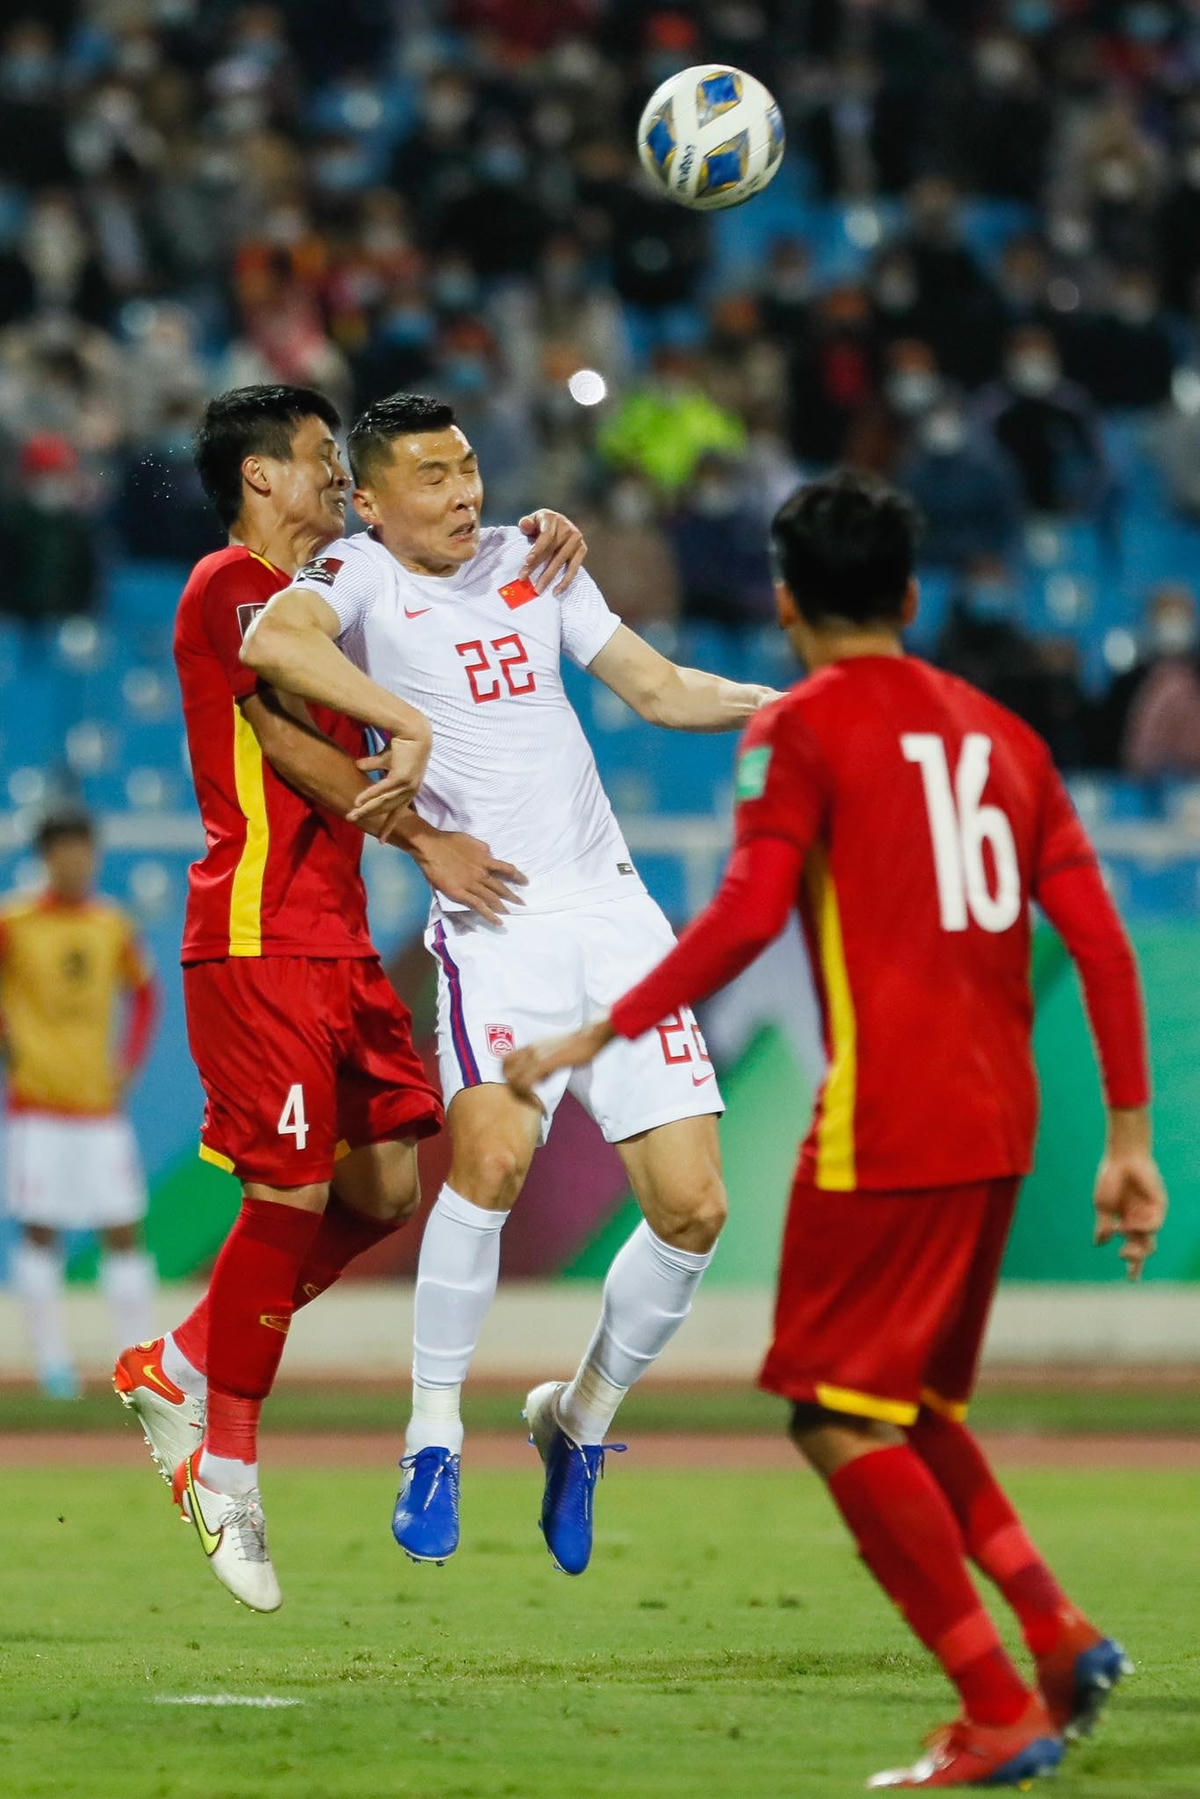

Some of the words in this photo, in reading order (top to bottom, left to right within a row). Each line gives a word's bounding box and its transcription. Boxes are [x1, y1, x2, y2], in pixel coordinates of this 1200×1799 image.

[454, 633, 537, 704] 22
[900, 732, 1021, 933] 16
[277, 1084, 310, 1151] 4
